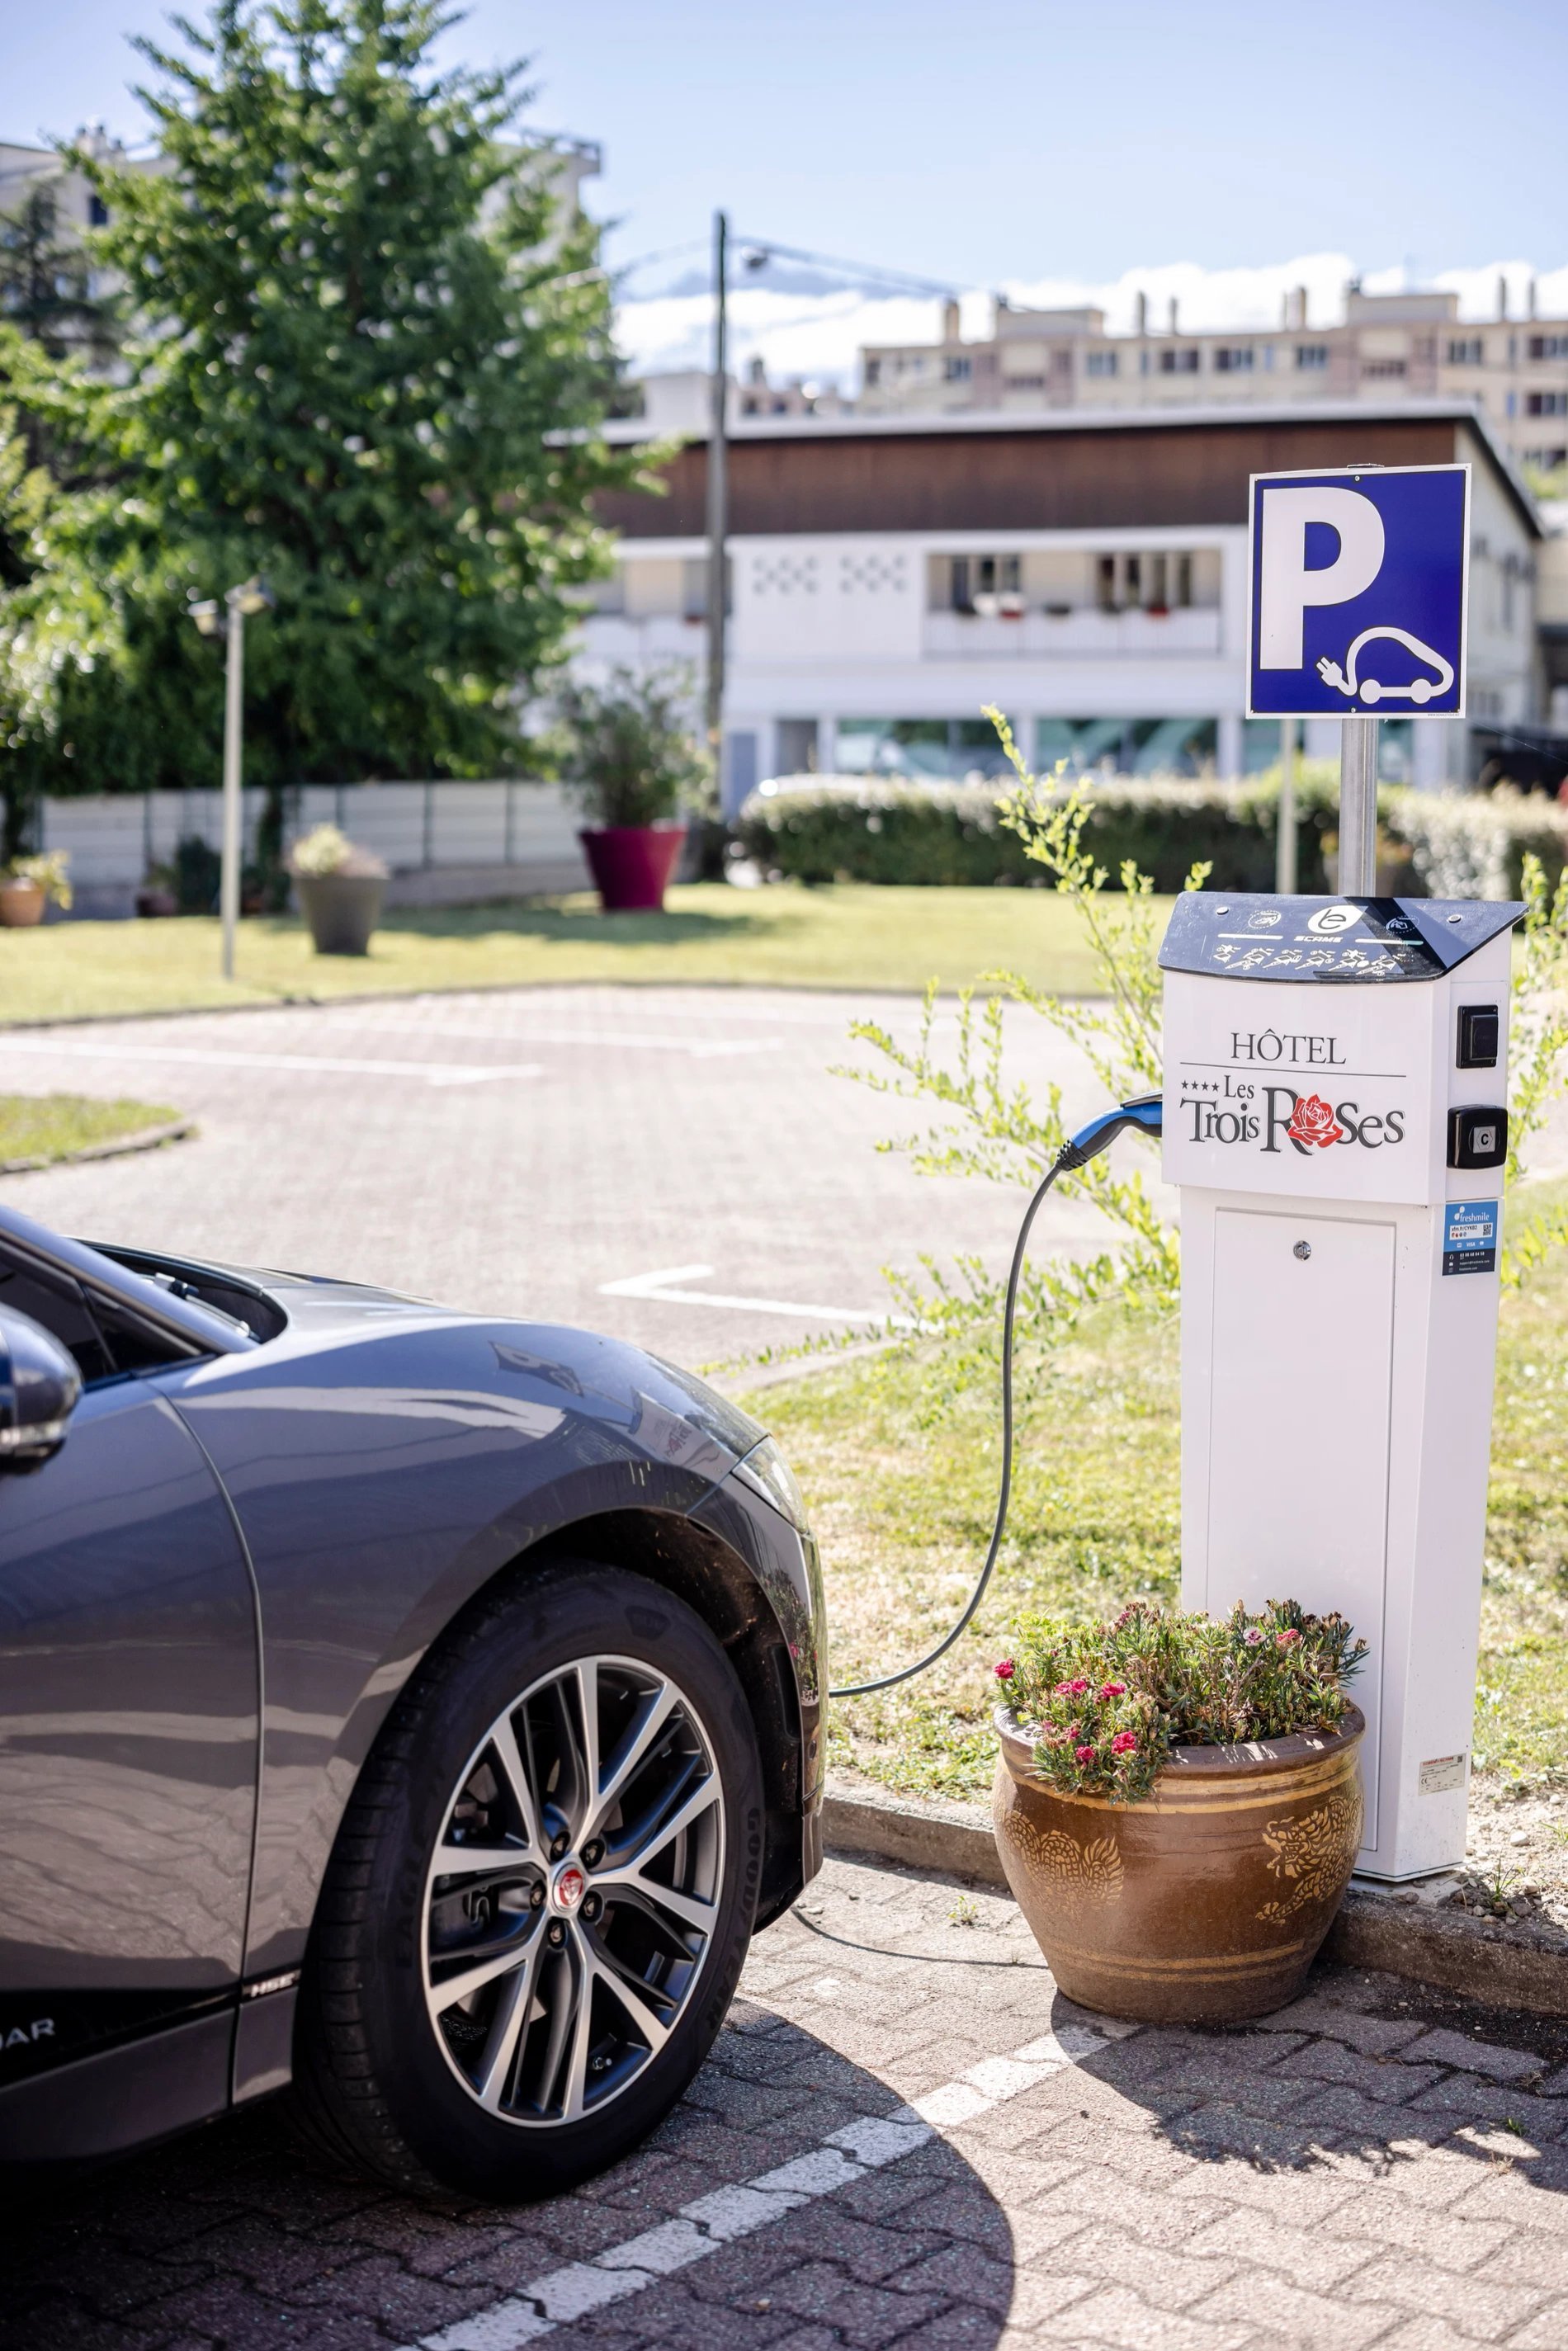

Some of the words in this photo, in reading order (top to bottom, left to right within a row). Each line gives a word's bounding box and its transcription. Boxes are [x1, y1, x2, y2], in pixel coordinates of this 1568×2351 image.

[1259, 486, 1386, 670] P
[1293, 935, 1344, 943] SCAME
[1230, 1028, 1347, 1065] HÔTEL
[1224, 1074, 1254, 1099] Les
[1179, 1097, 1261, 1144] Trois
[1260, 1086, 1406, 1155] Rses
[1480, 1133, 1489, 1145] C
[1460, 1211, 1490, 1222] freshmile
[0, 2018, 56, 2050] AR
